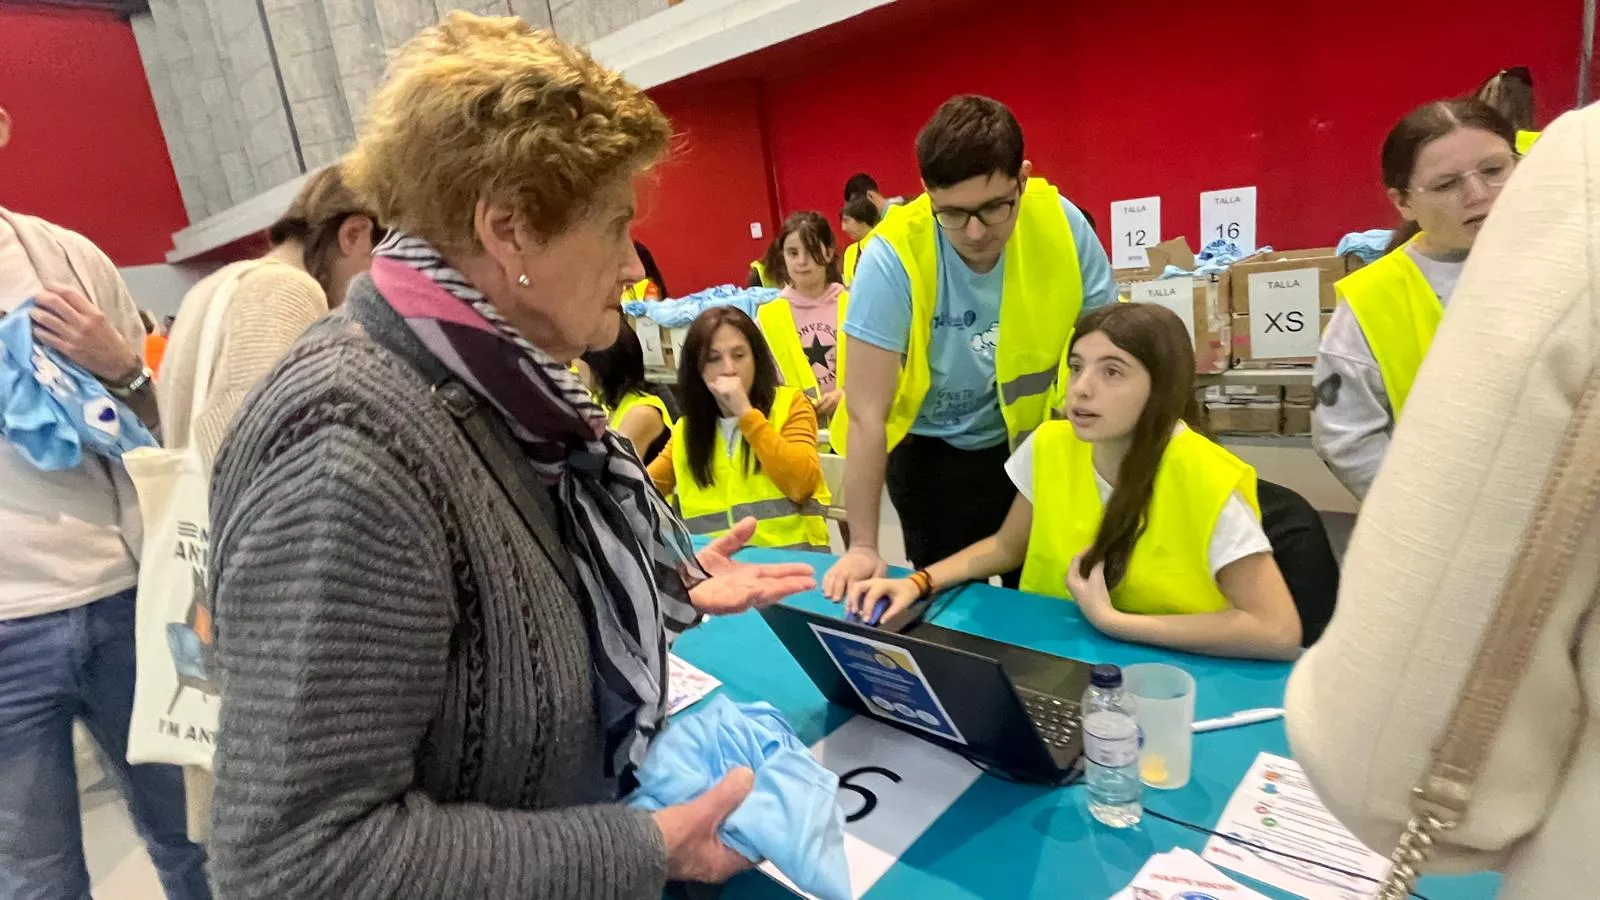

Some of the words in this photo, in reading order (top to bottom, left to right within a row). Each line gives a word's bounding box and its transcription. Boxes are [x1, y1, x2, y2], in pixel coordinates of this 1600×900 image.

[1215, 196, 1241, 204] TALLA
[1124, 205, 1146, 214] TALLA
[1216, 222, 1240, 239] 16
[1125, 230, 1146, 247] 12
[1267, 280, 1300, 289] TALLA
[1147, 288, 1176, 297] TALLA
[1264, 311, 1304, 333] XS
[839, 766, 903, 823] S
